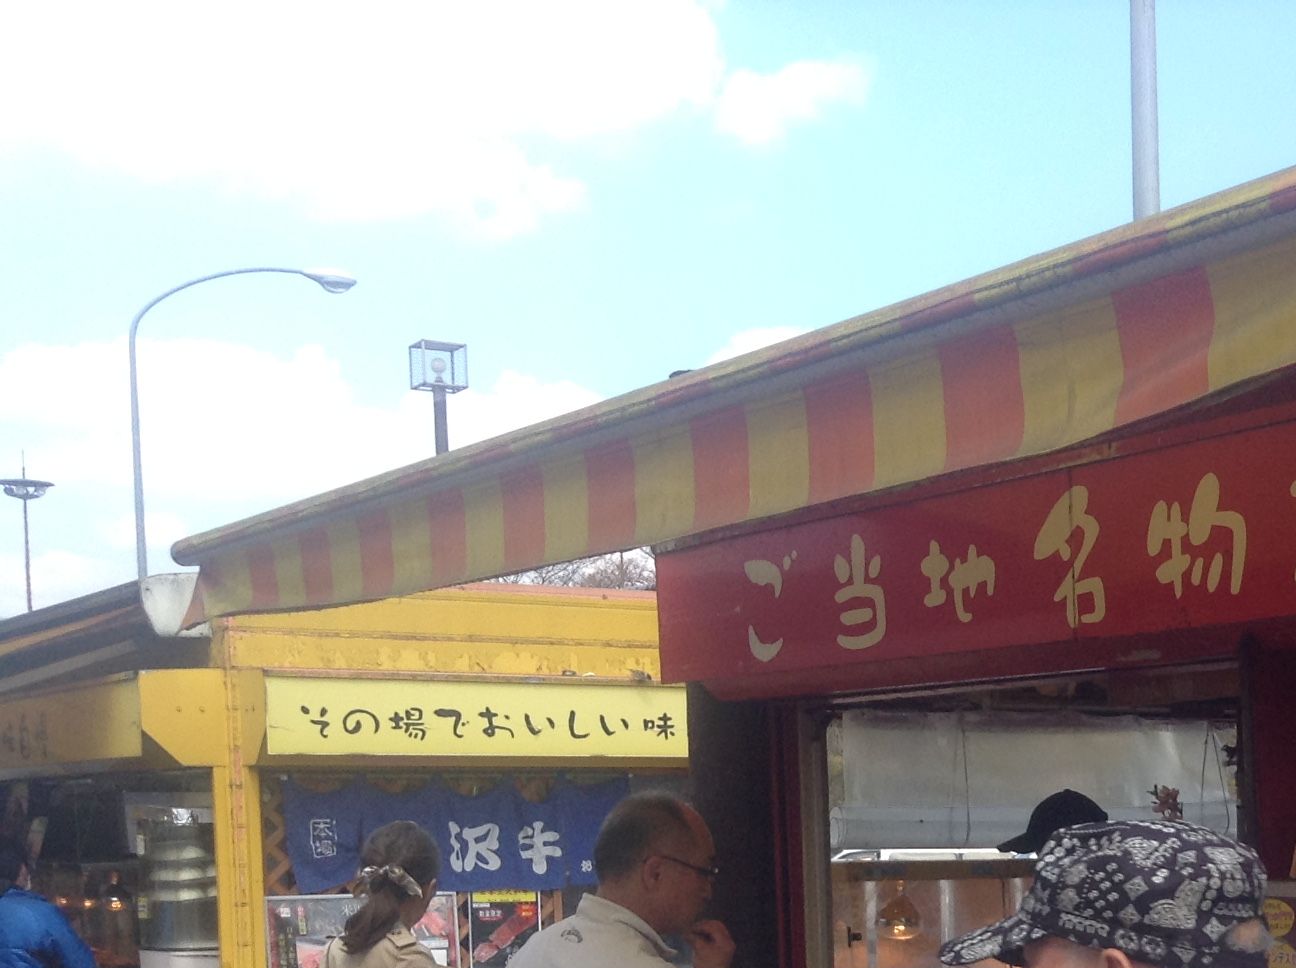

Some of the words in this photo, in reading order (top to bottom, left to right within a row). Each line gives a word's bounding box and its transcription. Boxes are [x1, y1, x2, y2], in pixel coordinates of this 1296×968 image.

[300, 705, 676, 740] その場でおいしい味
[311, 818, 337, 858] 本場
[448, 820, 563, 875] 沢牛
